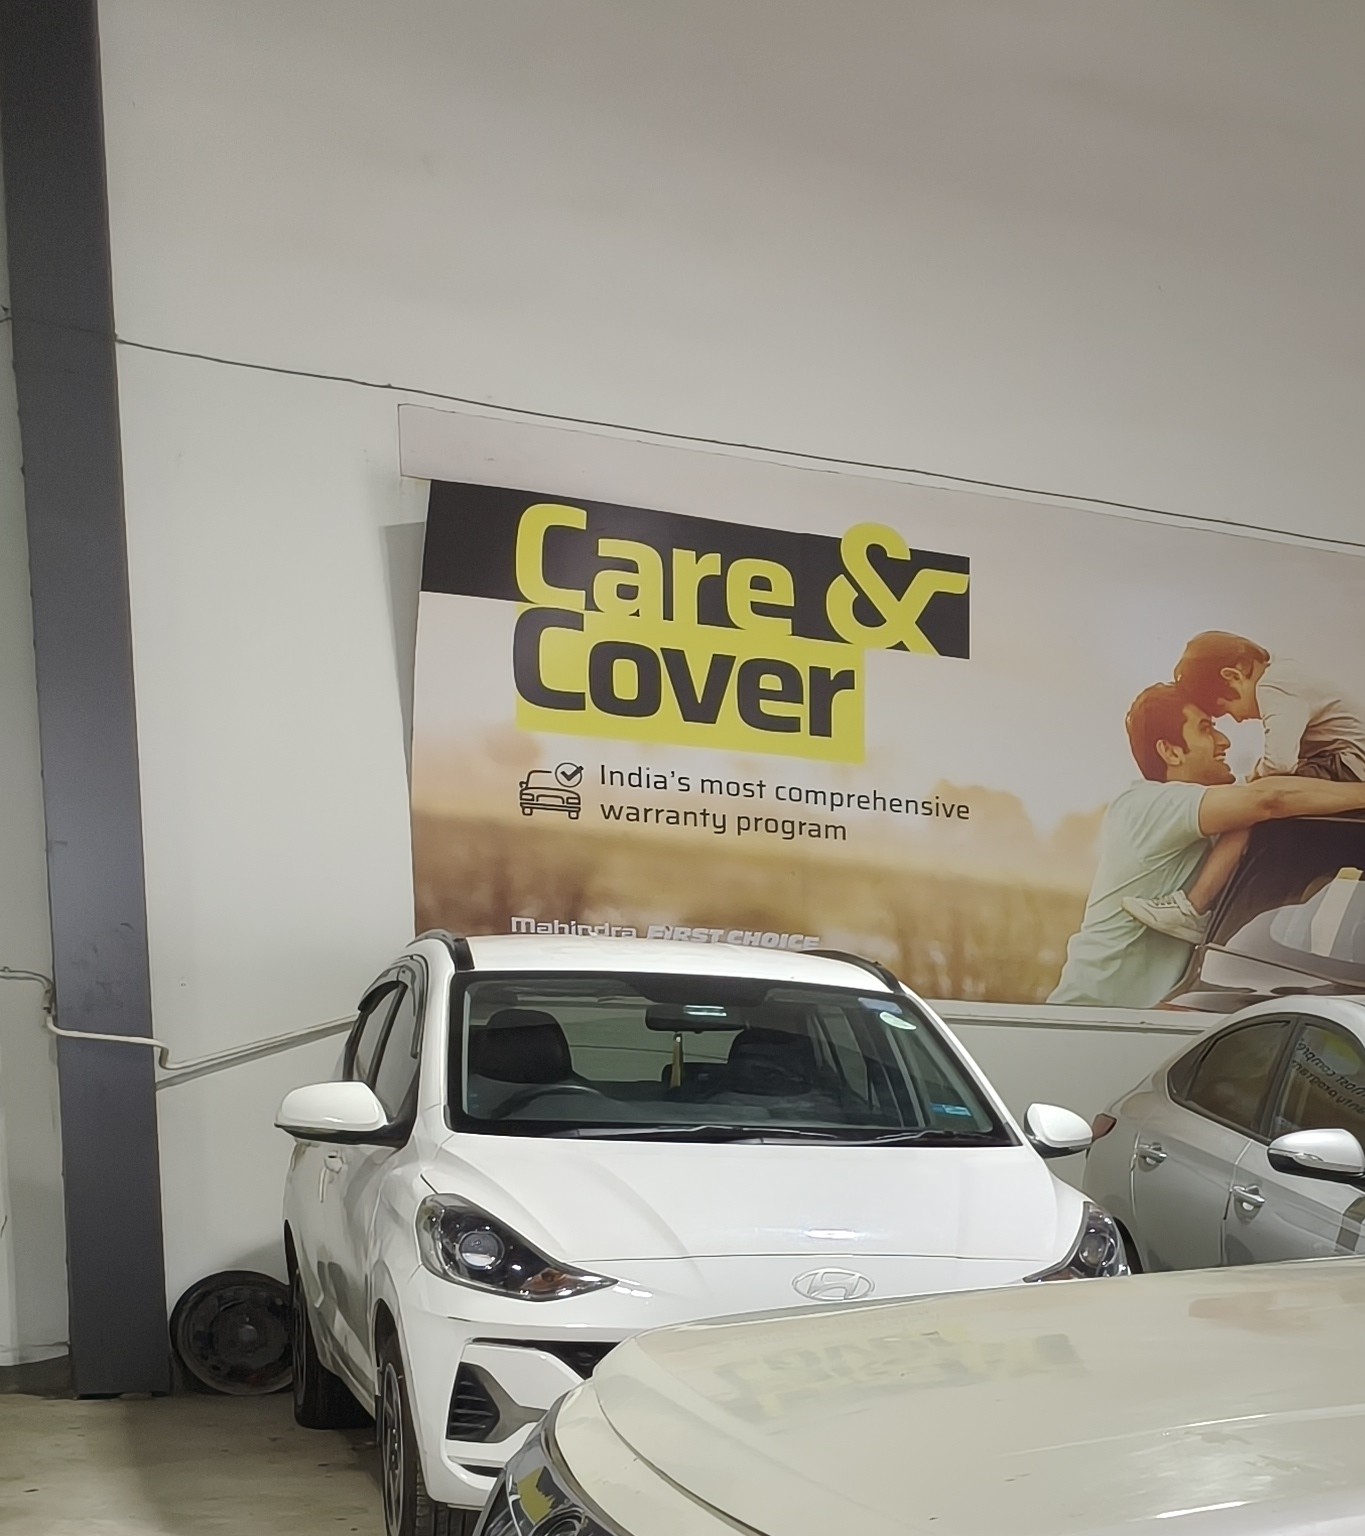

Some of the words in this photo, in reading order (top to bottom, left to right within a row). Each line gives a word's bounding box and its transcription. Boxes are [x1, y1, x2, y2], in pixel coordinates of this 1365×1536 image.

[515, 503, 795, 636] Care
[825, 522, 970, 657] &
[513, 606, 856, 739] Cover
[600, 764, 691, 793] India's
[700, 776, 767, 799] most
[775, 783, 970, 820] comprehensive
[600, 803, 727, 834] warranty
[737, 814, 847, 841] program
[727, 929, 821, 949] CHOICE
